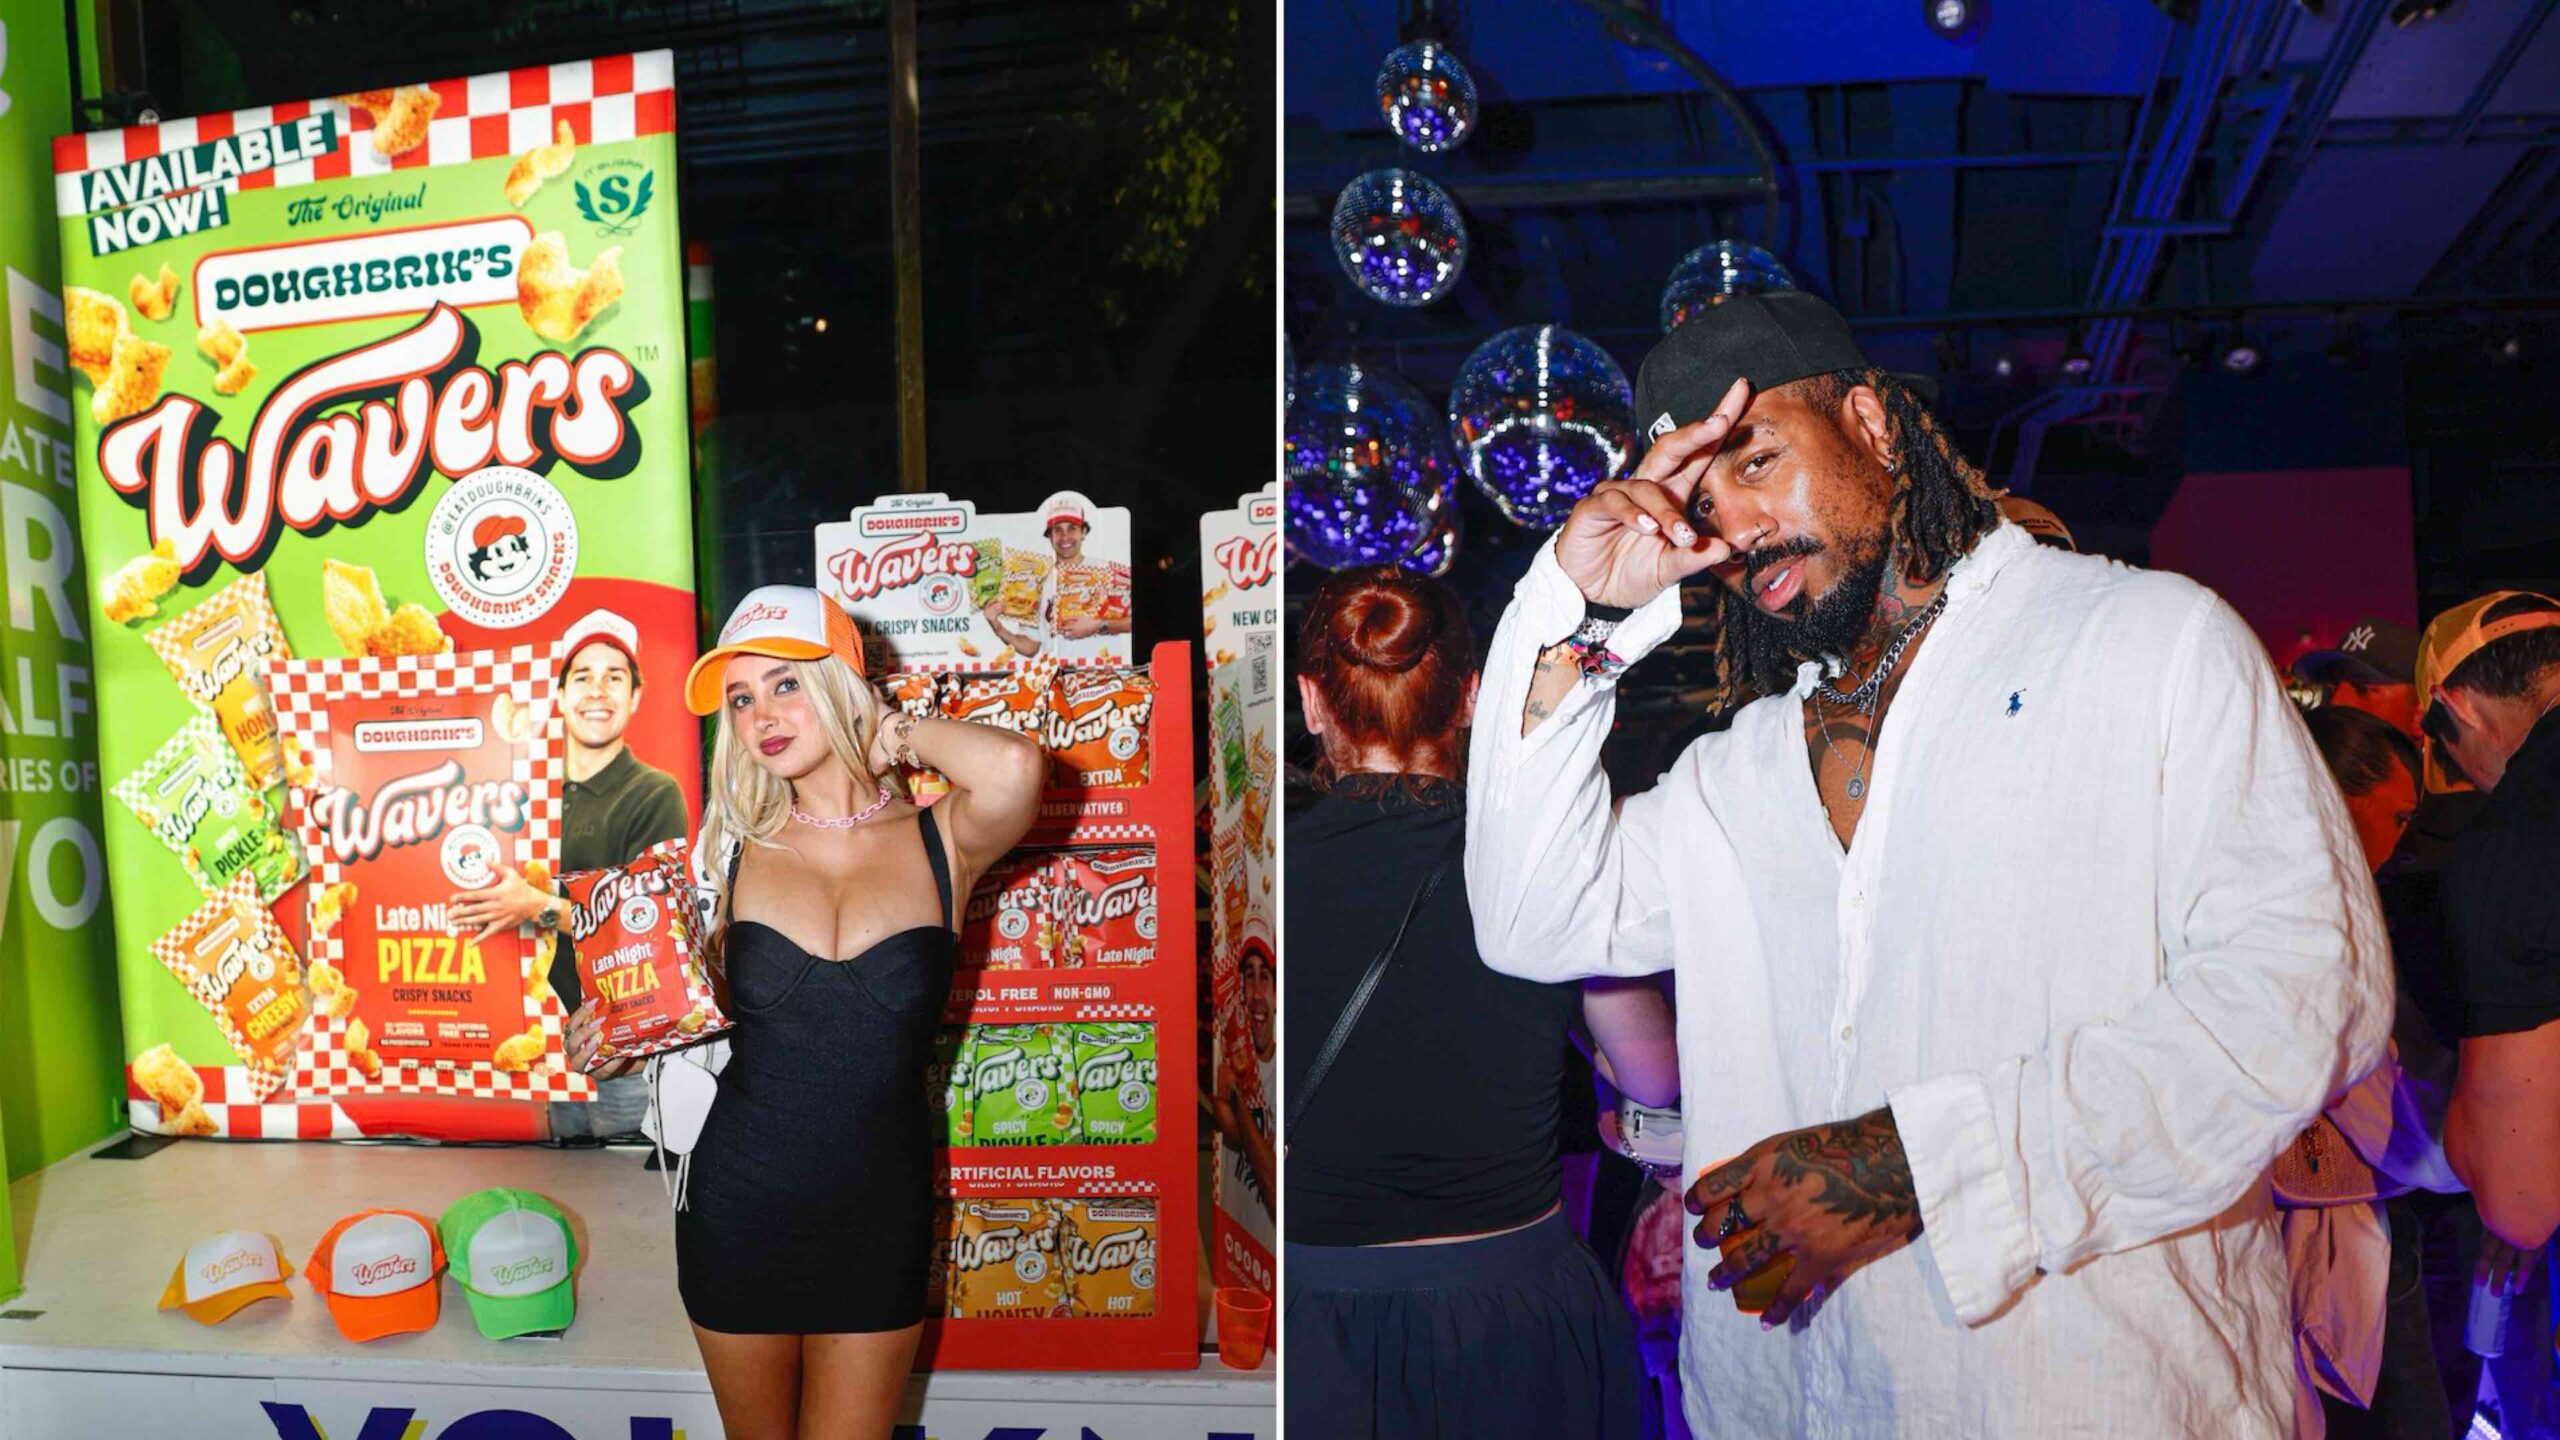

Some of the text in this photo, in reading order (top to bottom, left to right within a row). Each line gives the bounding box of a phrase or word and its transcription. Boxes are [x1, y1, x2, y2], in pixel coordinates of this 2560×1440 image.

[88, 116, 327, 214] AVAILABLE
[287, 181, 427, 226] The Original
[93, 187, 223, 256] NOW!
[215, 243, 513, 312] DOUGHBRIK'S
[101, 300, 645, 580] Wavers
[827, 530, 979, 602] Wavers
[876, 619, 918, 635] CRISPY
[922, 617, 970, 634] SNACKS
[1233, 612, 1260, 627] NEW
[1048, 699, 1152, 750] Wavers
[59, 760, 97, 793] OF
[1080, 767, 1123, 787] EXTRA
[311, 757, 528, 865] Wavers
[214, 830, 263, 878] PICKLE
[375, 903, 420, 932] Late
[571, 867, 670, 942] Wavers
[377, 937, 487, 984] PIZZA
[592, 942, 653, 976] Late Night
[1096, 949, 1122, 963] Late
[392, 988, 473, 1004] CRISPY SNACKS
[595, 960, 662, 1005] PIZZA
[1000, 987, 1039, 1001] FREE
[1054, 986, 1111, 999] NON-GMO
[1037, 1165, 1116, 1181] FLAVORS
[957, 1225, 1053, 1271] Wavers
[350, 1252, 417, 1286] Wavers
[491, 1254, 555, 1287] Wavers
[996, 1290, 1022, 1307] HOT
[1107, 1295, 1133, 1311] HOT
